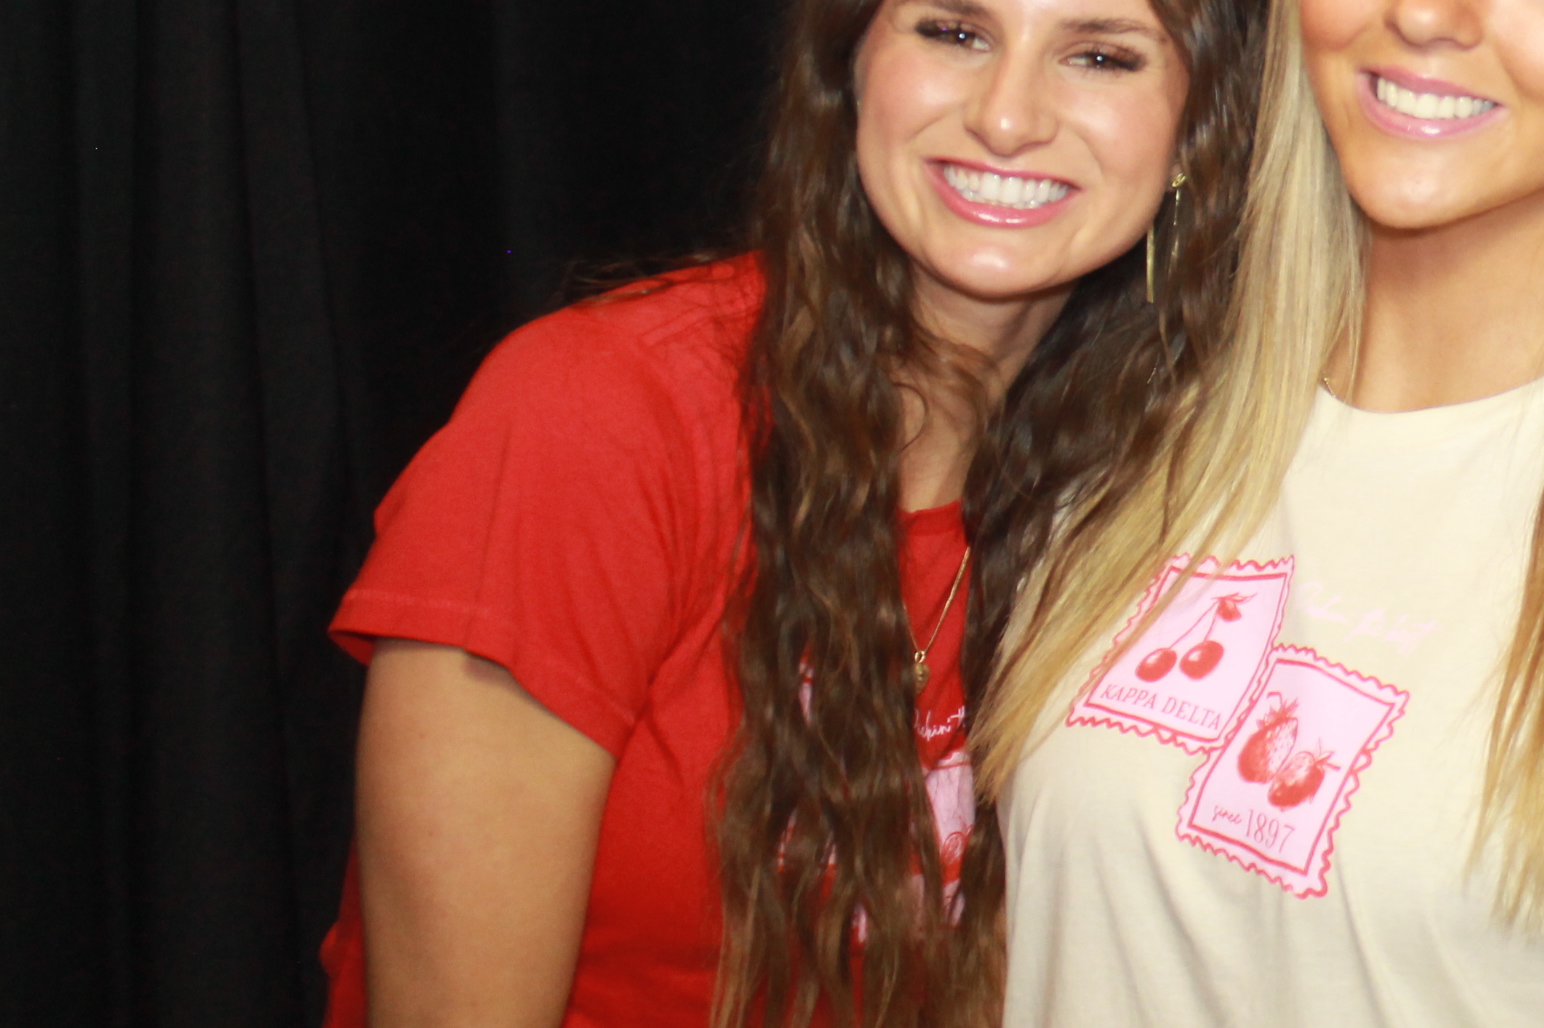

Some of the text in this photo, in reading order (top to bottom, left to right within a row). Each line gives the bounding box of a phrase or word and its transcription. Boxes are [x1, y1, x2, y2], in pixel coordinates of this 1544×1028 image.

[1100, 683, 1222, 731] KAPPA DELTA
[1212, 805, 1296, 854] since 1897
